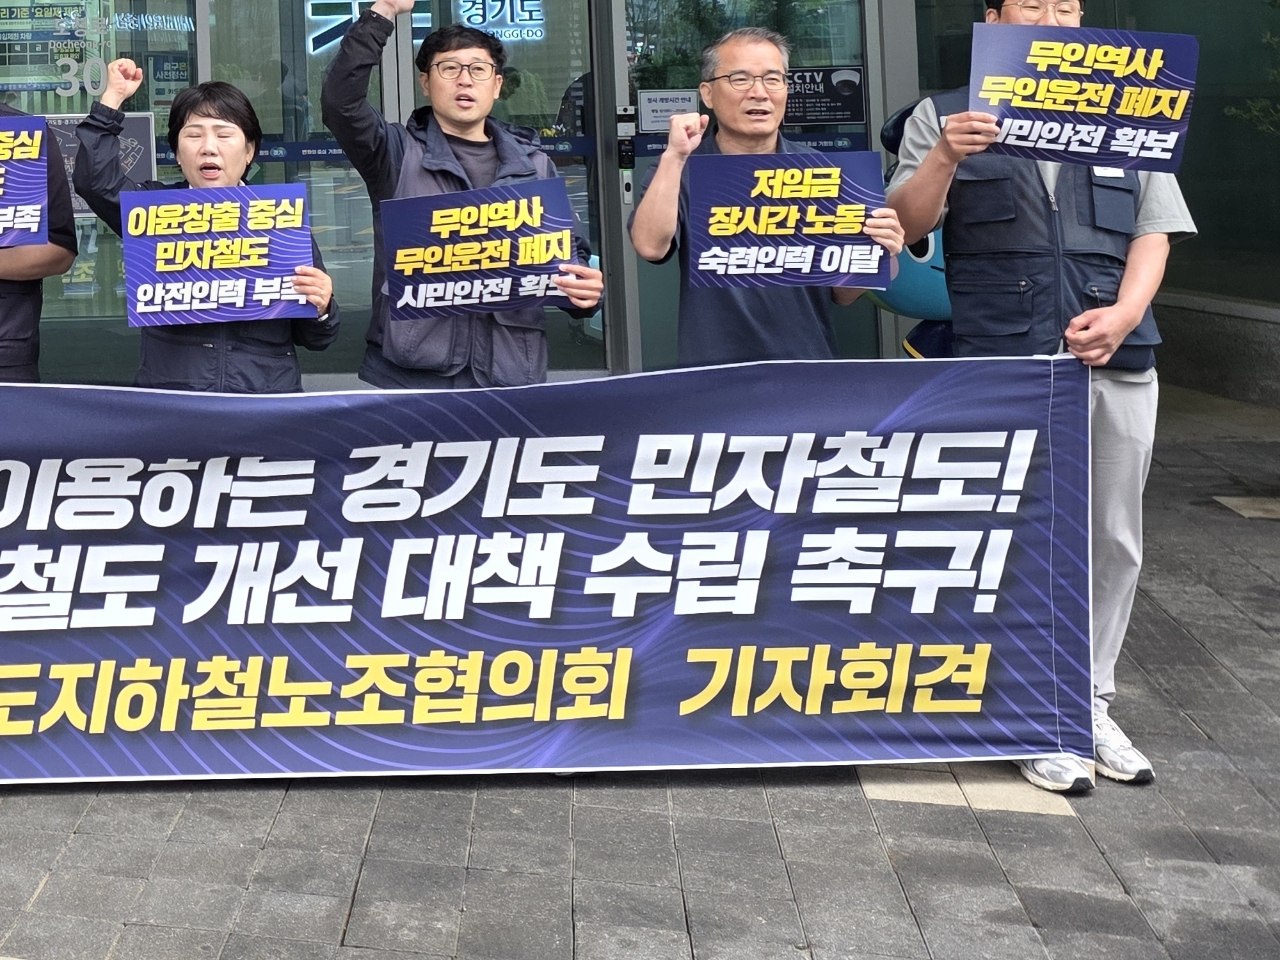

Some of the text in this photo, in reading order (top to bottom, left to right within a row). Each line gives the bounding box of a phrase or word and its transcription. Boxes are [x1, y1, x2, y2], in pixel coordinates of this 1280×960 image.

[49, 39, 112, 49] Docheong-ro
[1026, 41, 1164, 80] 무인역사
[56, 58, 107, 97] 30
[787, 72, 823, 83] CCTV
[787, 83, 824, 93] 설치안내
[978, 76, 1190, 120] 무인운전 폐지
[1110, 127, 1179, 159] 확보
[750, 167, 841, 199] 저임금
[128, 201, 240, 236] 이윤창출
[247, 198, 304, 230] 중심
[430, 196, 544, 238] 무인역사
[708, 203, 867, 237] 장시간 노동
[155, 237, 269, 272] 민자철도
[393, 229, 571, 276] 무인운전 폐지
[697, 244, 884, 276] 숙련인력 이탈
[136, 276, 307, 313] 안전인력 부족
[396, 277, 512, 310] 시민안전
[341, 434, 606, 524] 경기도
[626, 429, 1040, 516] 민자철도!
[181, 536, 362, 627] 개선
[385, 532, 564, 622] 대책
[584, 528, 769, 619] 수립
[790, 527, 1015, 616] 촉구!
[678, 642, 992, 720] 기자회견
